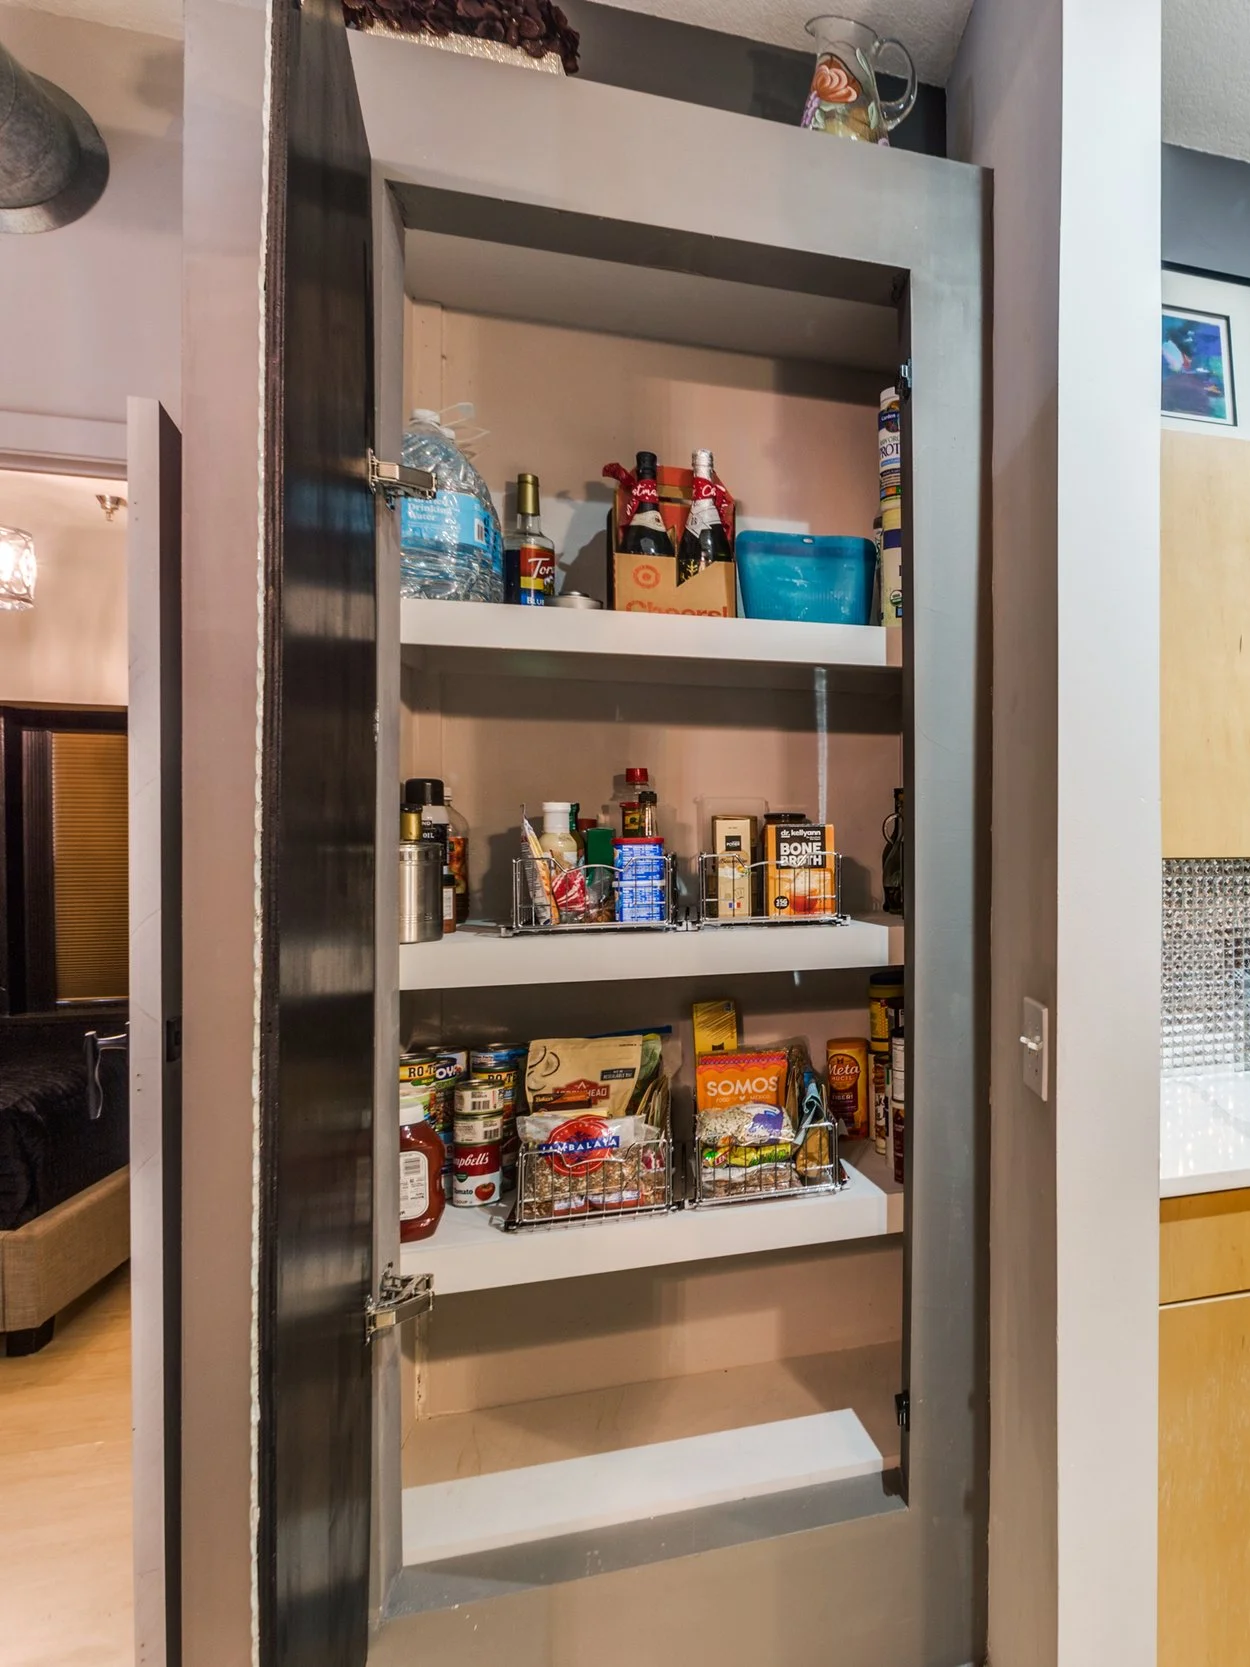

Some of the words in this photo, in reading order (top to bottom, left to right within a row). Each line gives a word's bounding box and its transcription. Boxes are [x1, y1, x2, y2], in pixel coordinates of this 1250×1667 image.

[407, 510, 437, 521] Water
[780, 829, 790, 837] dr.
[791, 829, 821, 837] kellyann
[780, 841, 822, 856] BONE
[780, 855, 822, 867] BROTH
[706, 1076, 779, 1097] SOMOS
[541, 1137, 618, 1153] JAMBALAYA
